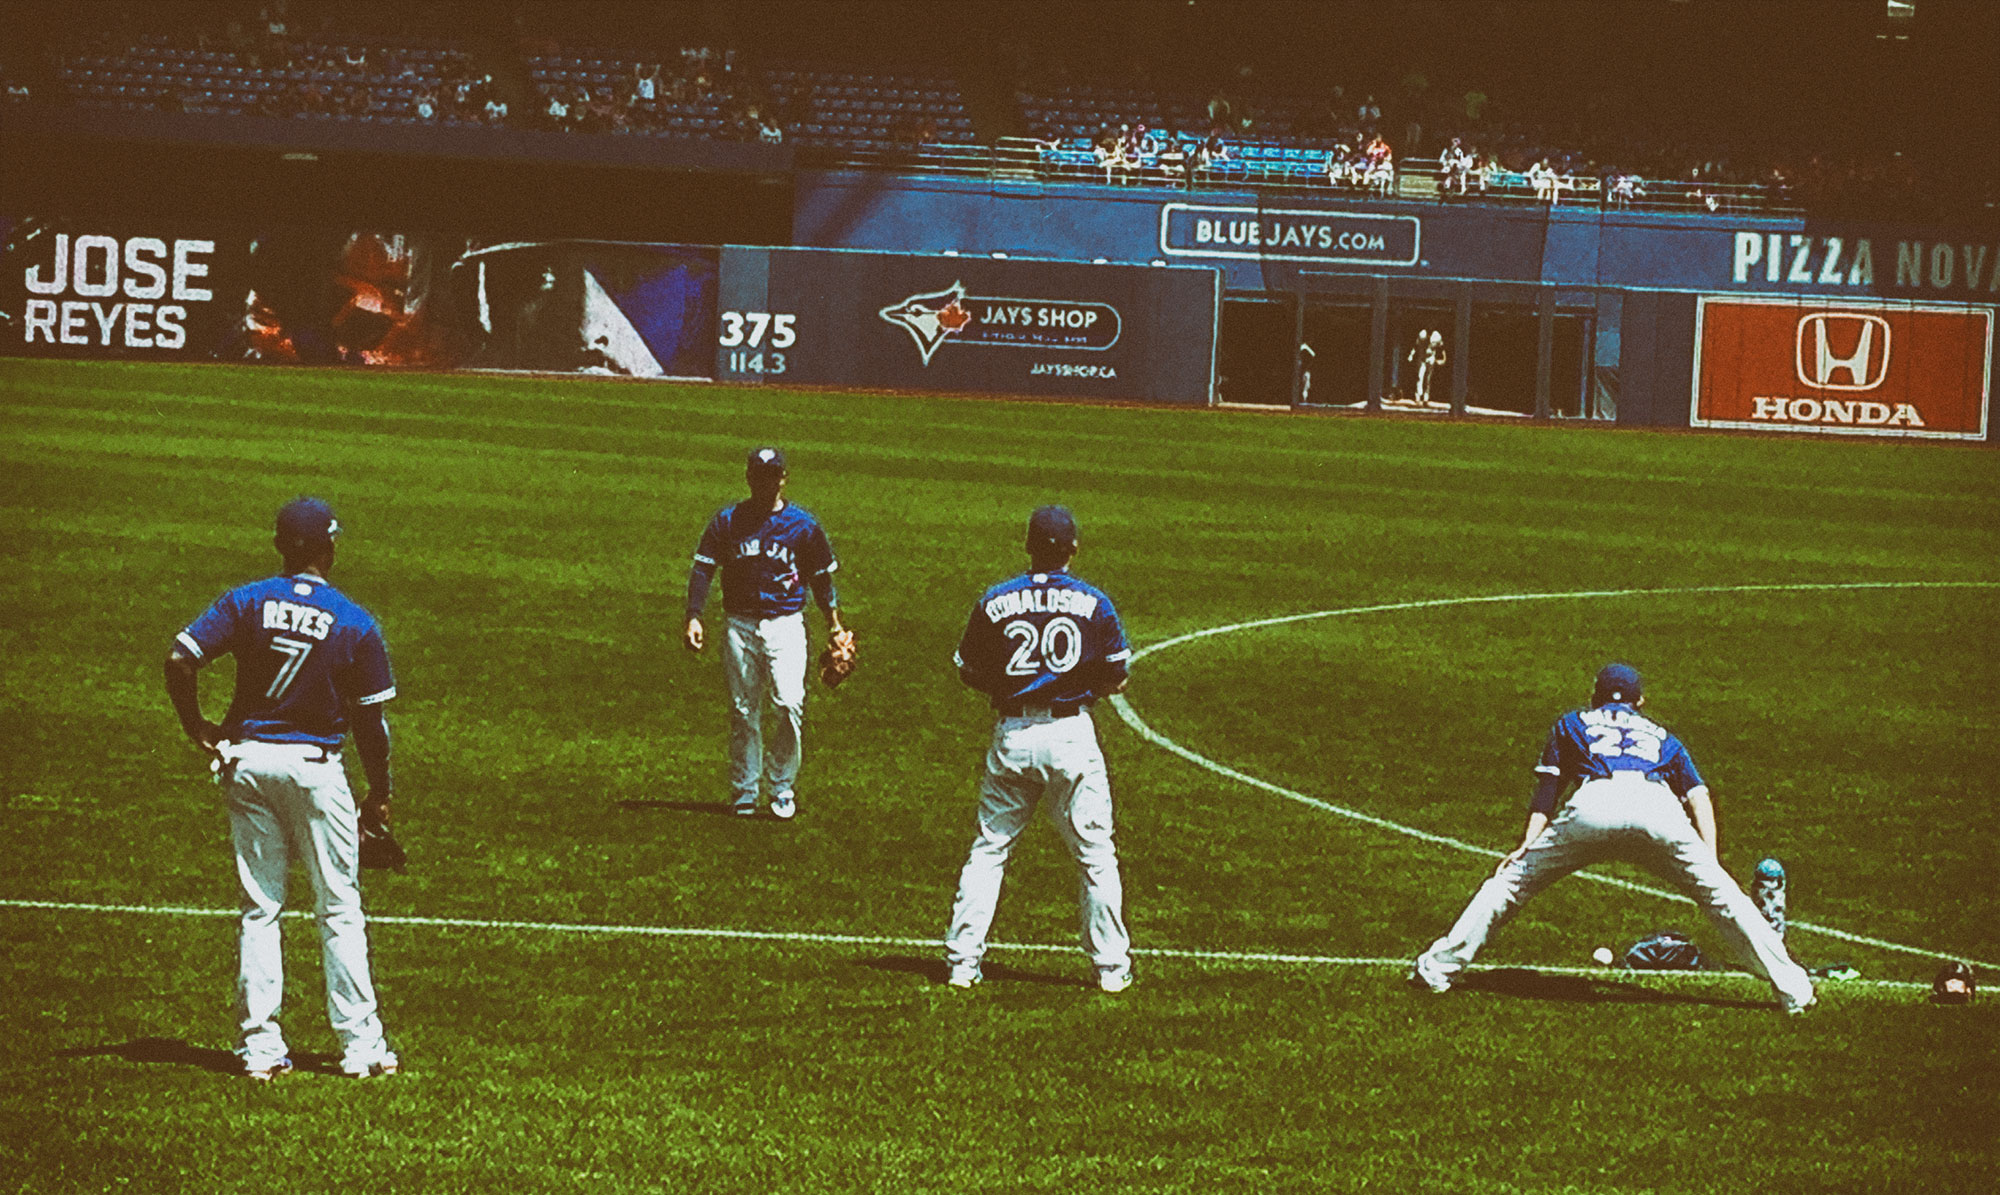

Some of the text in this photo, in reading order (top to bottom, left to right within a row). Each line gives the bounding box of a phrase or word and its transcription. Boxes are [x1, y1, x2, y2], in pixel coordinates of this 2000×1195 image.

[1196, 219, 1261, 246] BLUE
[25, 233, 215, 301] JOSE
[1733, 231, 1874, 285] PIZZA
[24, 299, 187, 349] REYES
[719, 311, 796, 348] 375
[980, 306, 1098, 329] JAYS SHOP
[730, 351, 786, 374] 114.3
[1751, 396, 1925, 427] HONDA
[263, 600, 335, 641] REYES
[1003, 616, 1082, 676] 20
[265, 636, 313, 698] 7
